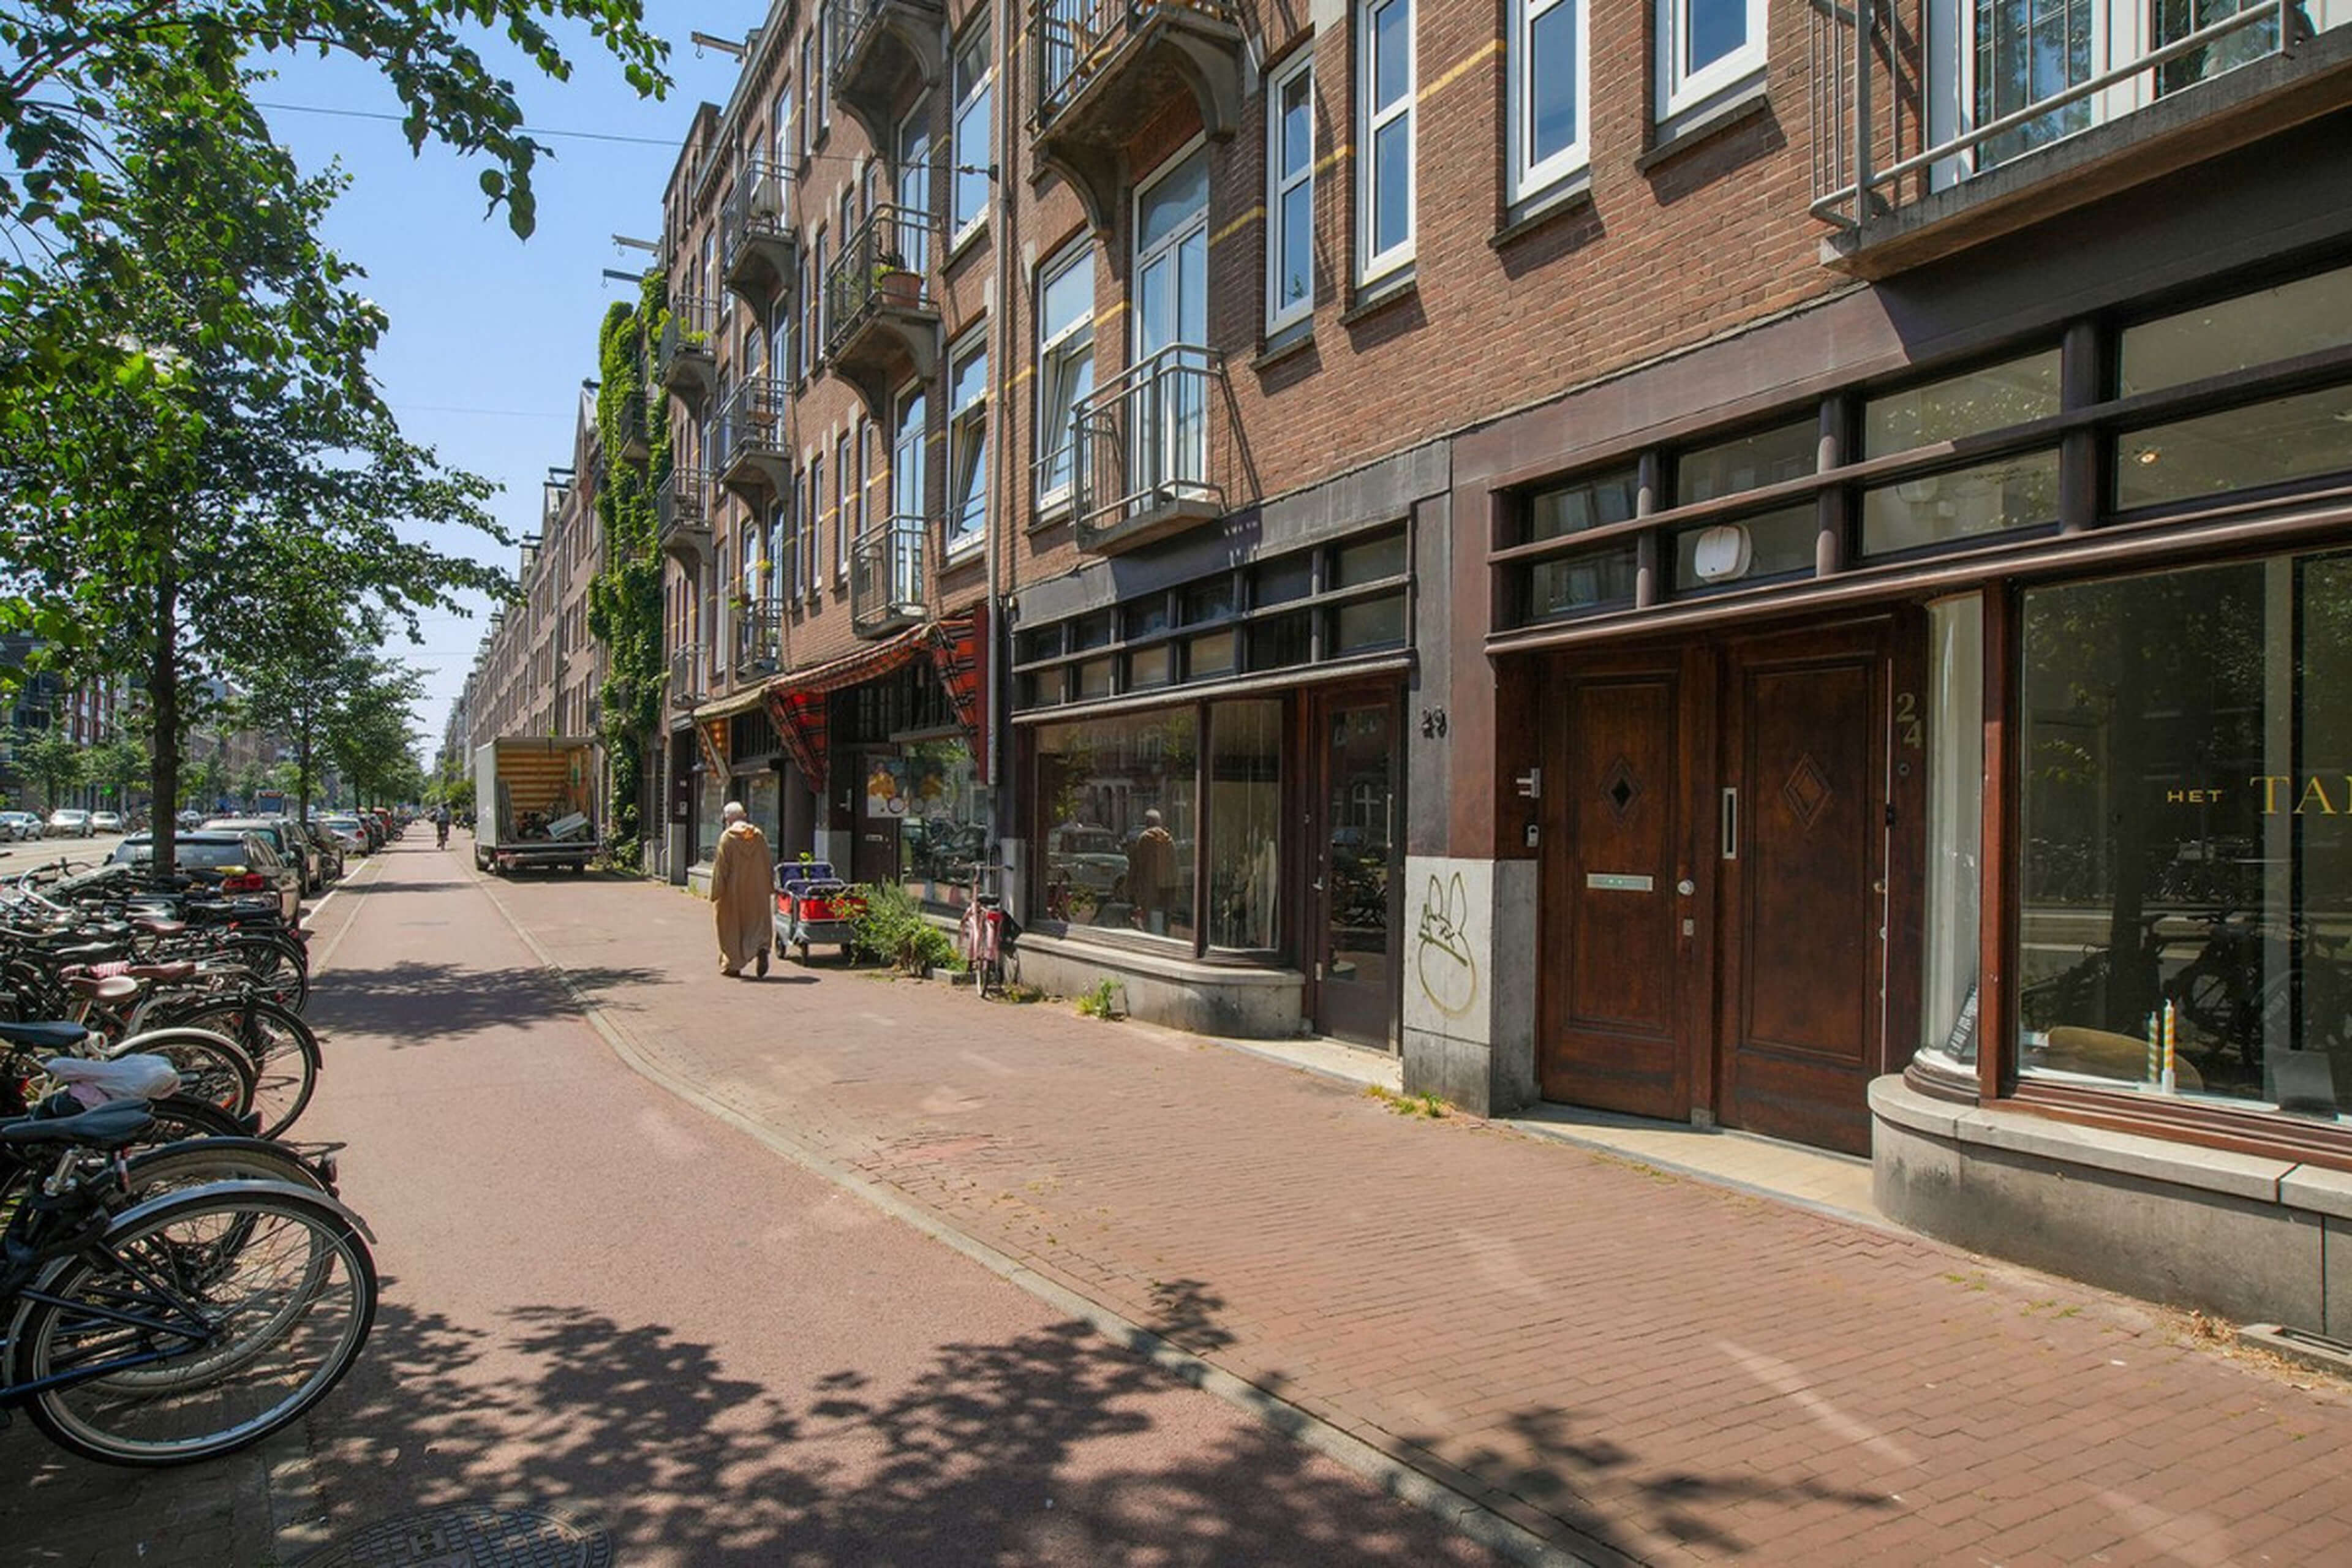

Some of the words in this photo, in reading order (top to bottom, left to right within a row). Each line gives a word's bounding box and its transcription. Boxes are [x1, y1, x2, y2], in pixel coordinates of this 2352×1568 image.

[1896, 692, 1922, 748] 24
[2166, 790, 2223, 803] HET
[2248, 774, 2352, 815] TA
